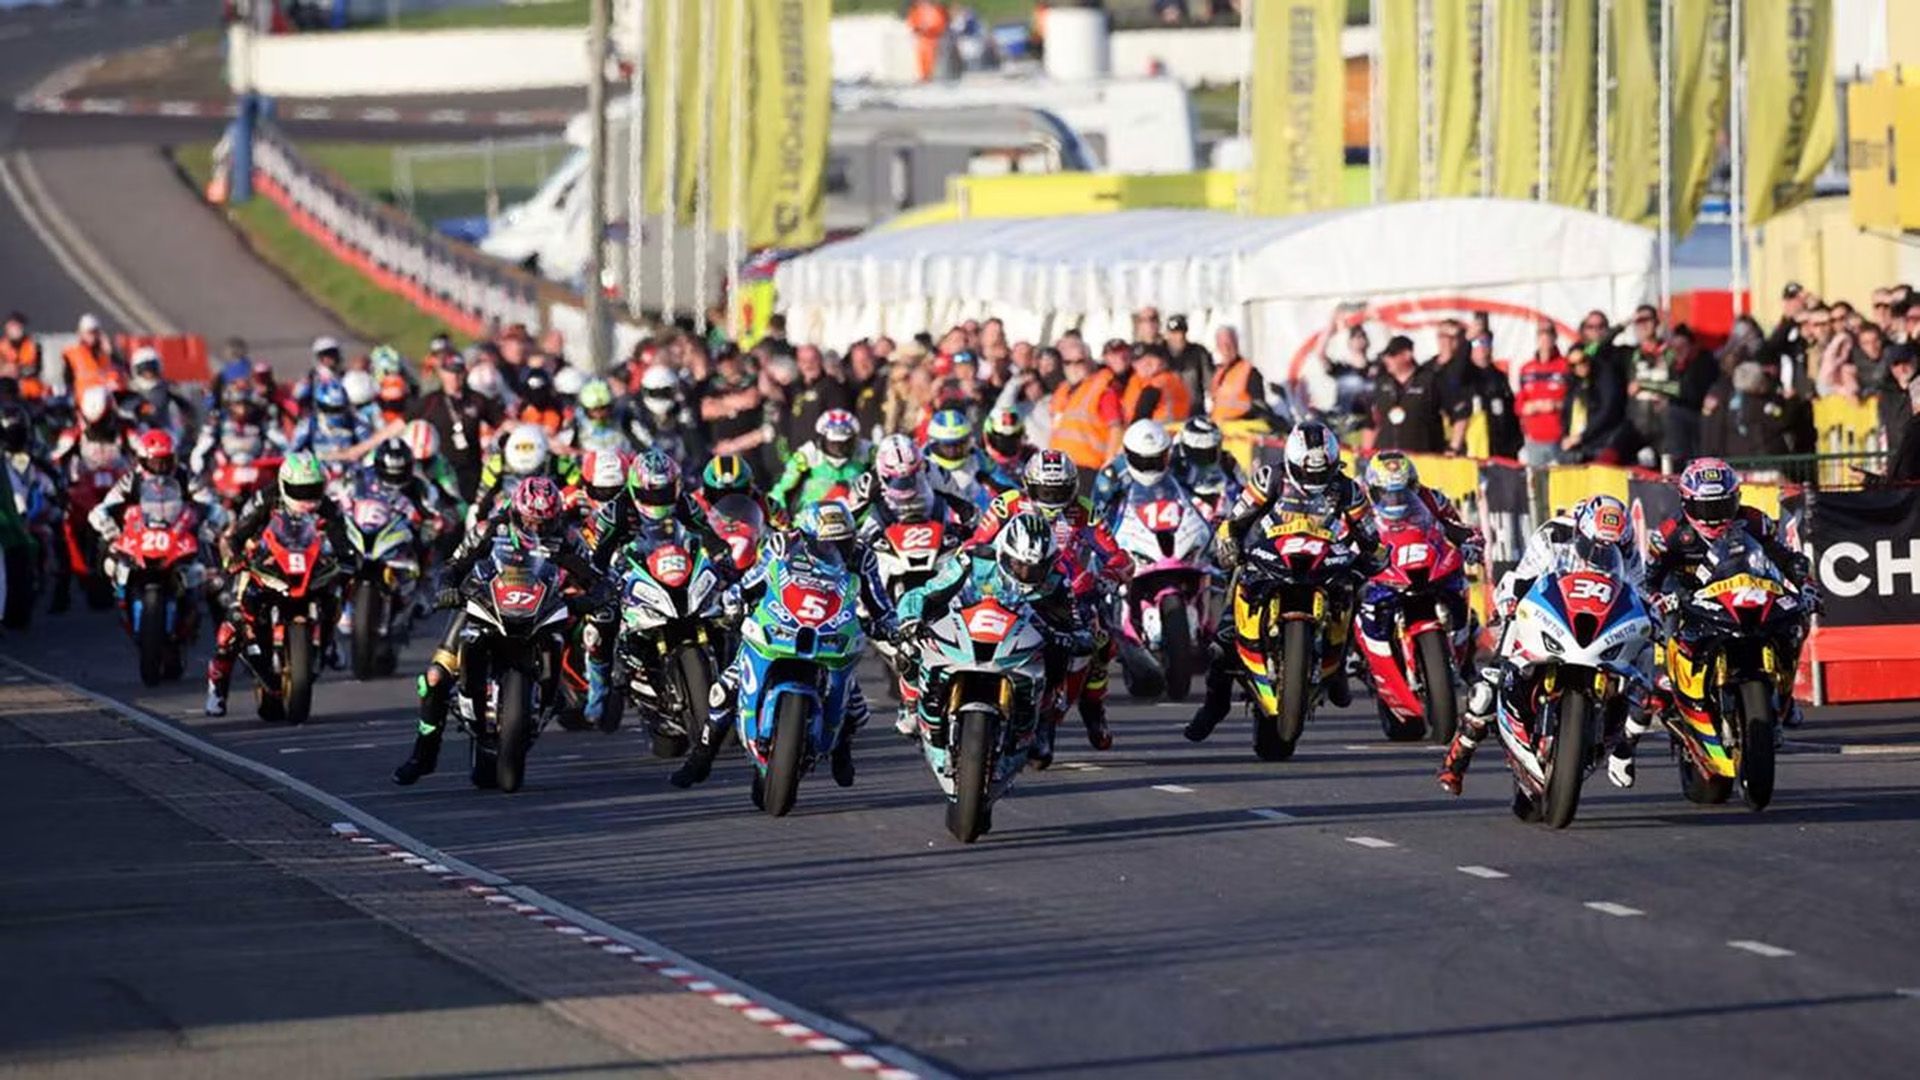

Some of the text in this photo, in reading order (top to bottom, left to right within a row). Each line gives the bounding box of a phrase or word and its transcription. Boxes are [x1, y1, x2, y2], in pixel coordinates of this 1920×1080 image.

[1143, 500, 1181, 530] 14
[141, 531, 170, 551] 20
[901, 527, 933, 549] 22
[1281, 537, 1325, 556] 24
[289, 553, 306, 573] 9
[1397, 543, 1429, 567] 15
[1569, 578, 1613, 603] 34
[796, 594, 828, 619] 5
[968, 609, 1009, 635] 6
